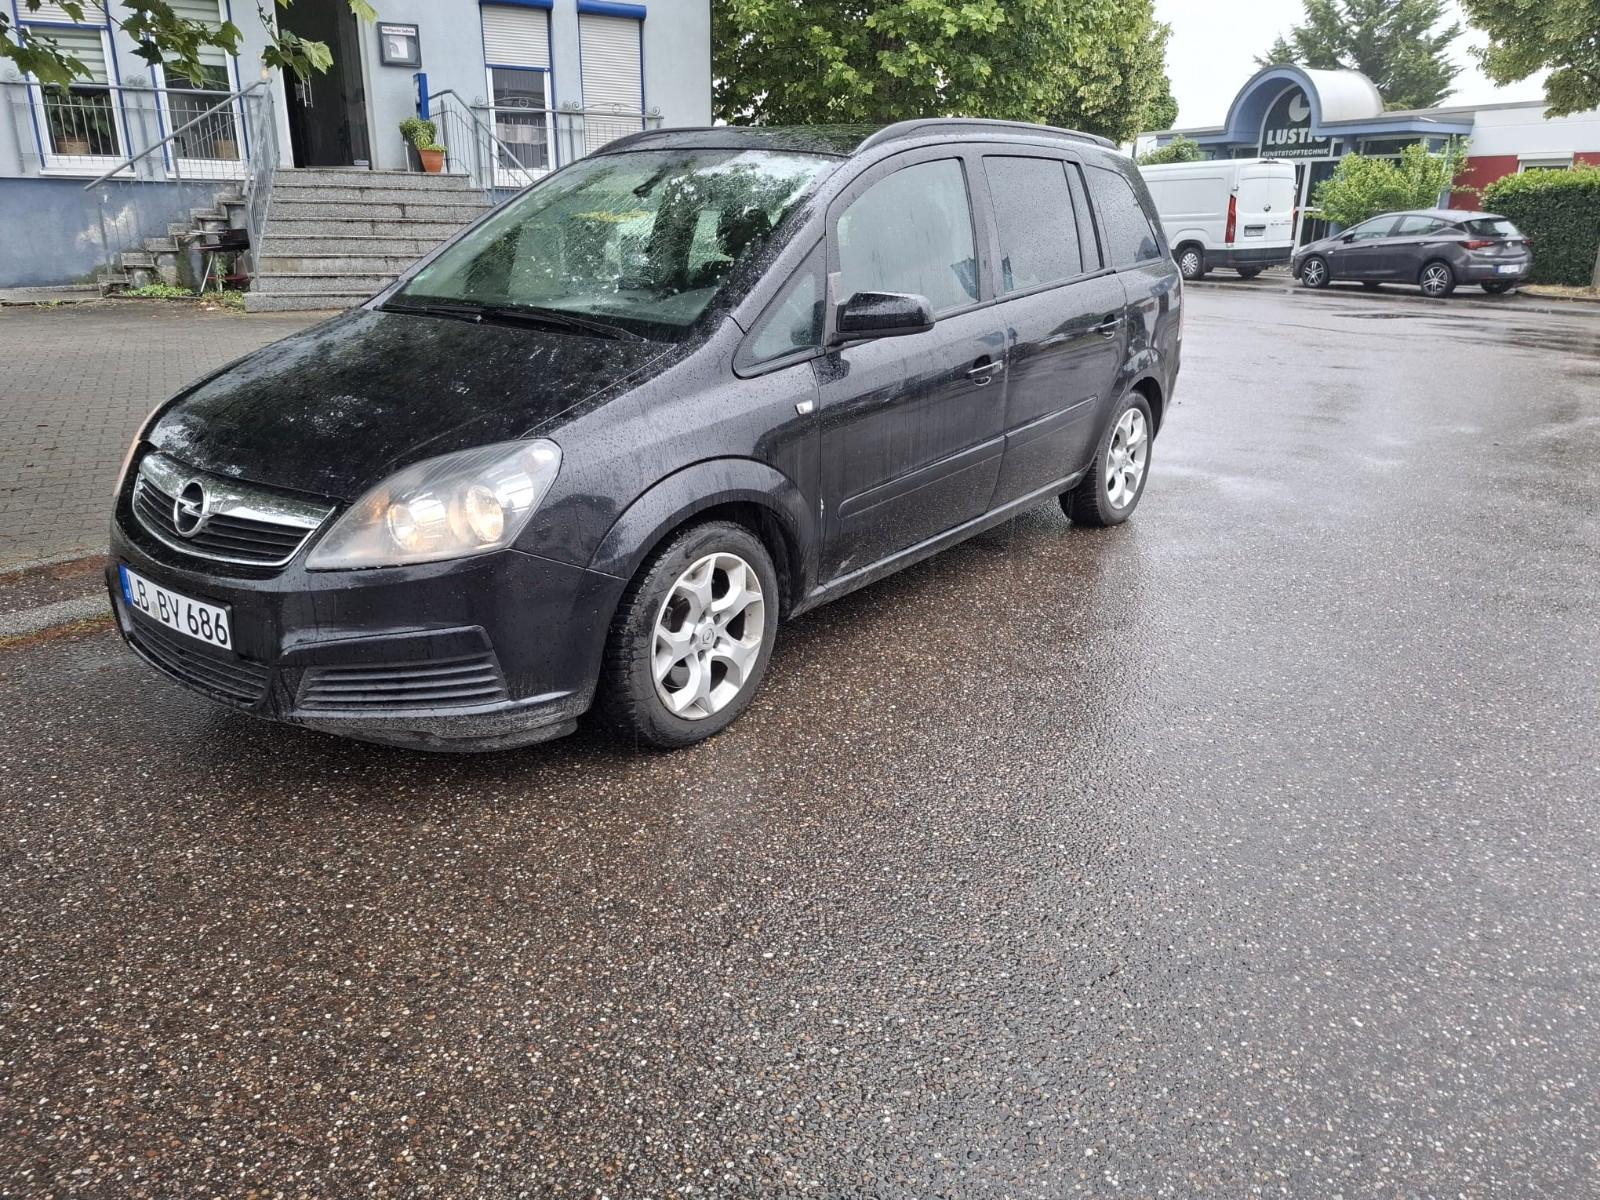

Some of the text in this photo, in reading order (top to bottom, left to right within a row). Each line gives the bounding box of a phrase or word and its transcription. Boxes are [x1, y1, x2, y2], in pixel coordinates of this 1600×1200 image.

[1262, 148, 1329, 157] KUNSTSTOFFTECHNIK
[128, 574, 228, 645] LB BY 686
